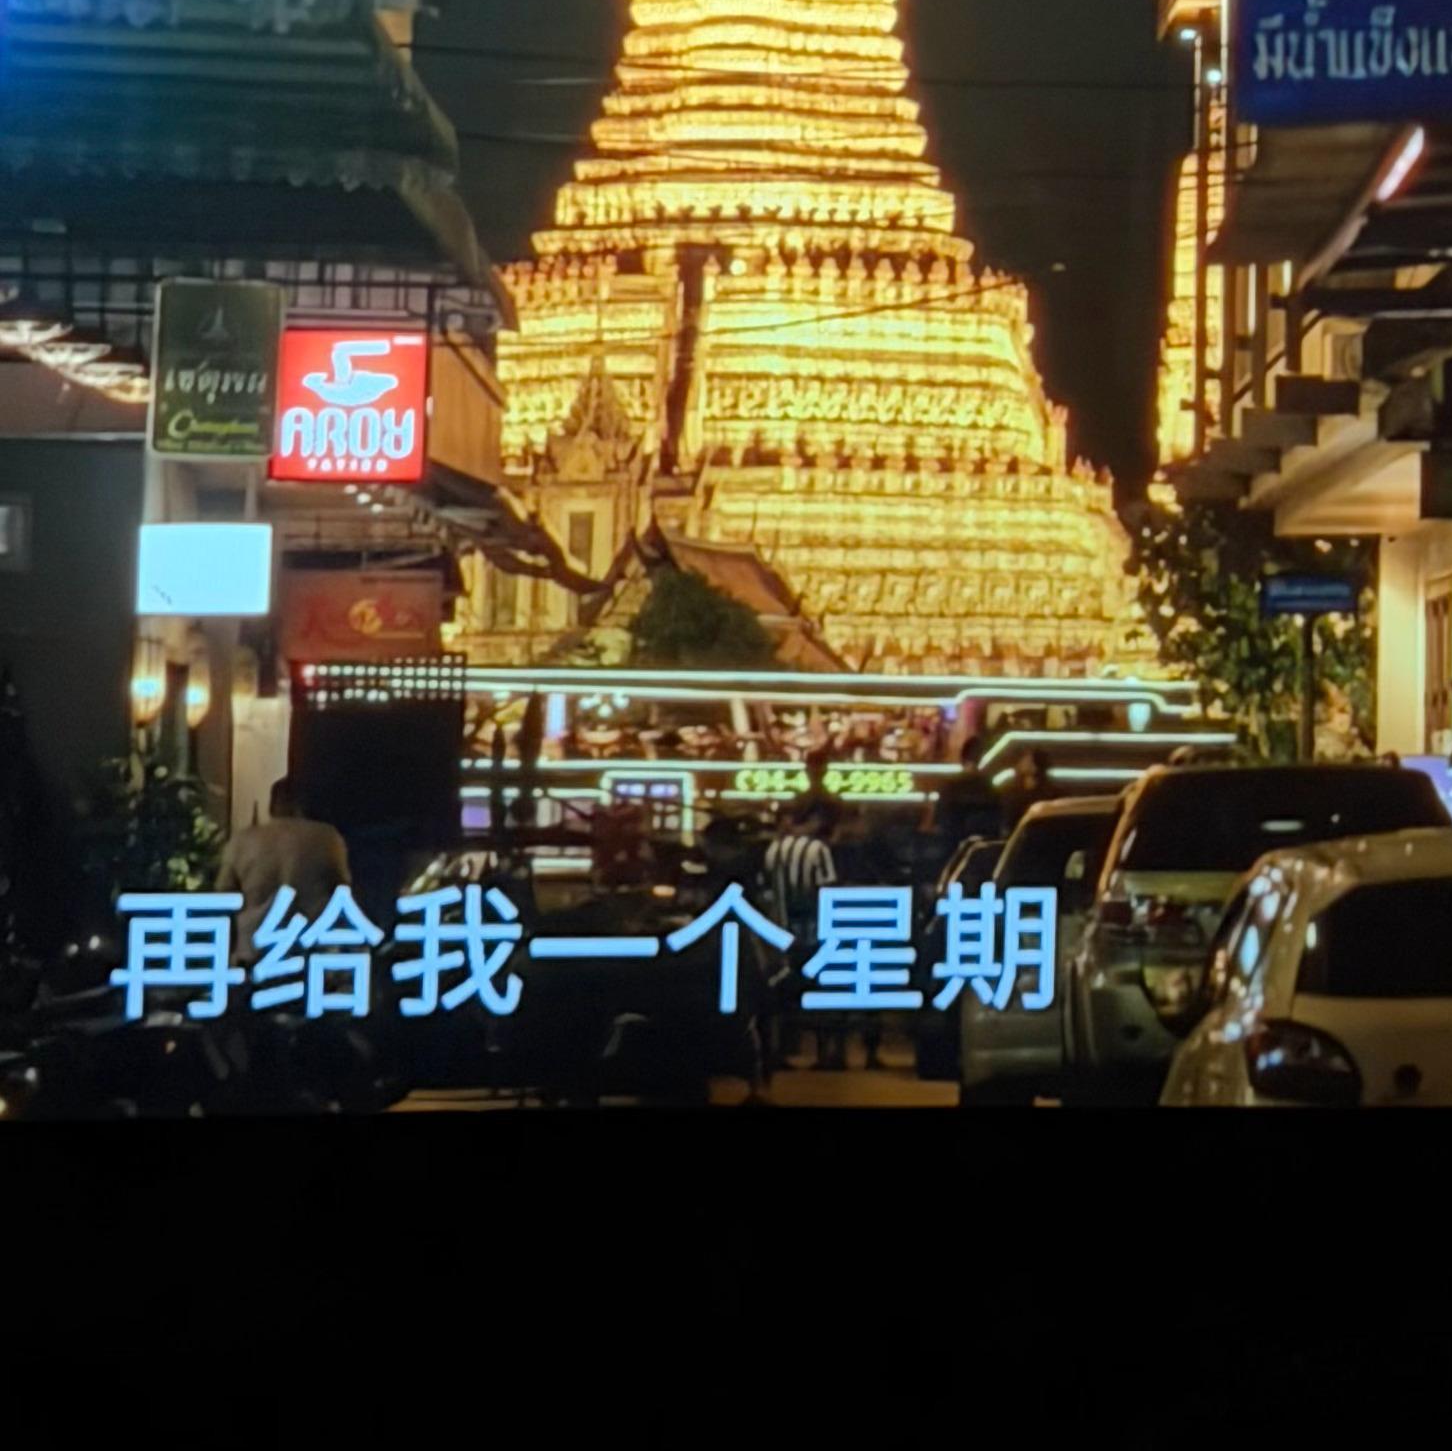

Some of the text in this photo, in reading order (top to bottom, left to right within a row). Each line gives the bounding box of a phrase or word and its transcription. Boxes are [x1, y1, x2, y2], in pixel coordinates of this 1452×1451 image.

[280, 407, 415, 459] AROY
[110, 881, 1059, 1022] 再给我一个星期
